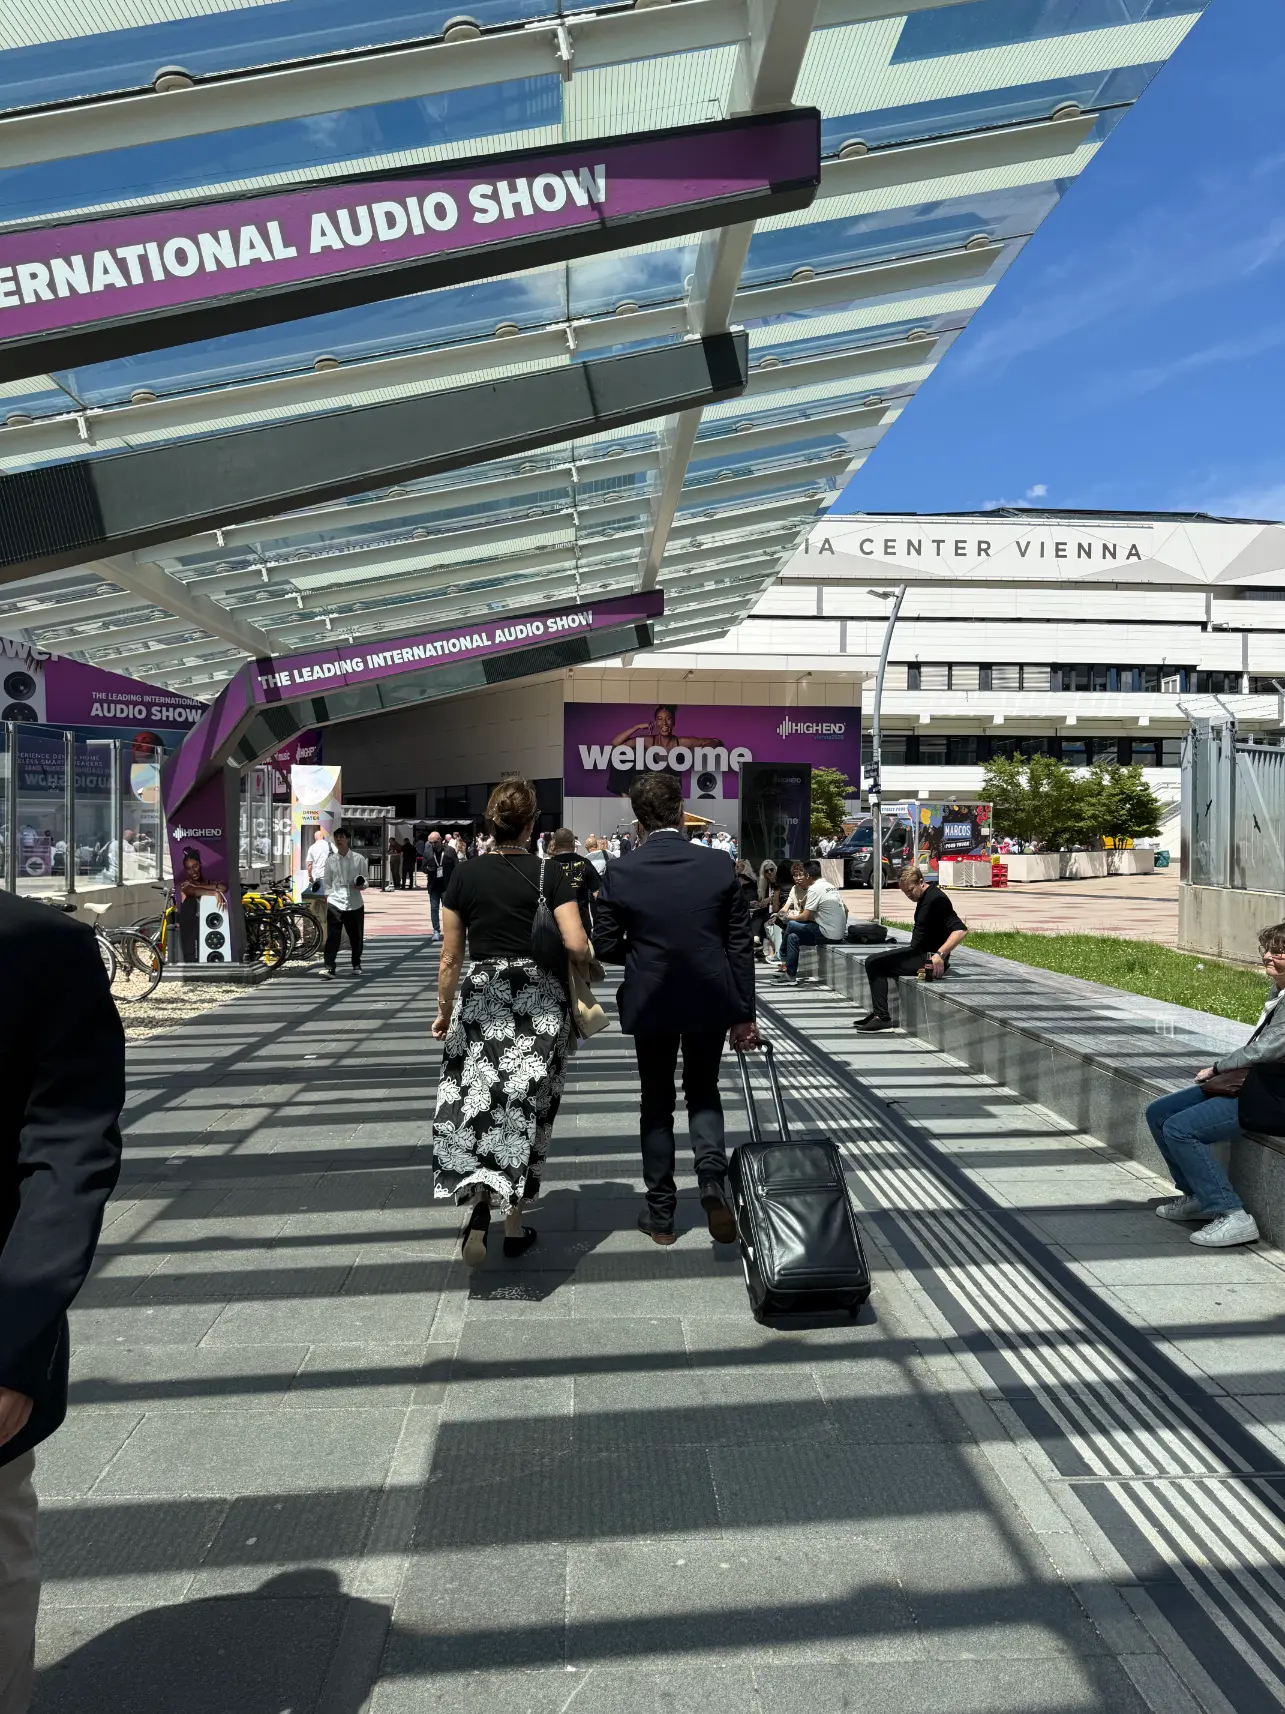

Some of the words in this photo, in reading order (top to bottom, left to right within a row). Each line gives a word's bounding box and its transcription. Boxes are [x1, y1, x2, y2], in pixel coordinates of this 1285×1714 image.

[0, 220, 297, 308] ERNATIONAL
[309, 191, 459, 254] AUDIO
[469, 163, 606, 225] SHOW
[859, 538, 992, 557] CENTER
[1016, 540, 1142, 561] VIENNA
[258, 671, 292, 690] THE
[293, 657, 364, 684] LEADING
[367, 632, 492, 669] INTERNATIONAL
[495, 620, 544, 643] AUDIO
[546, 610, 594, 633] SHOW
[92, 692, 107, 700] THE
[108, 693, 142, 702] LEADING
[143, 695, 202, 706] INTERNATIONAL
[90, 702, 147, 719] AUDIO
[151, 706, 202, 723] SHOW
[578, 737, 753, 772] welcome
[945, 825, 971, 836] MARCOS
